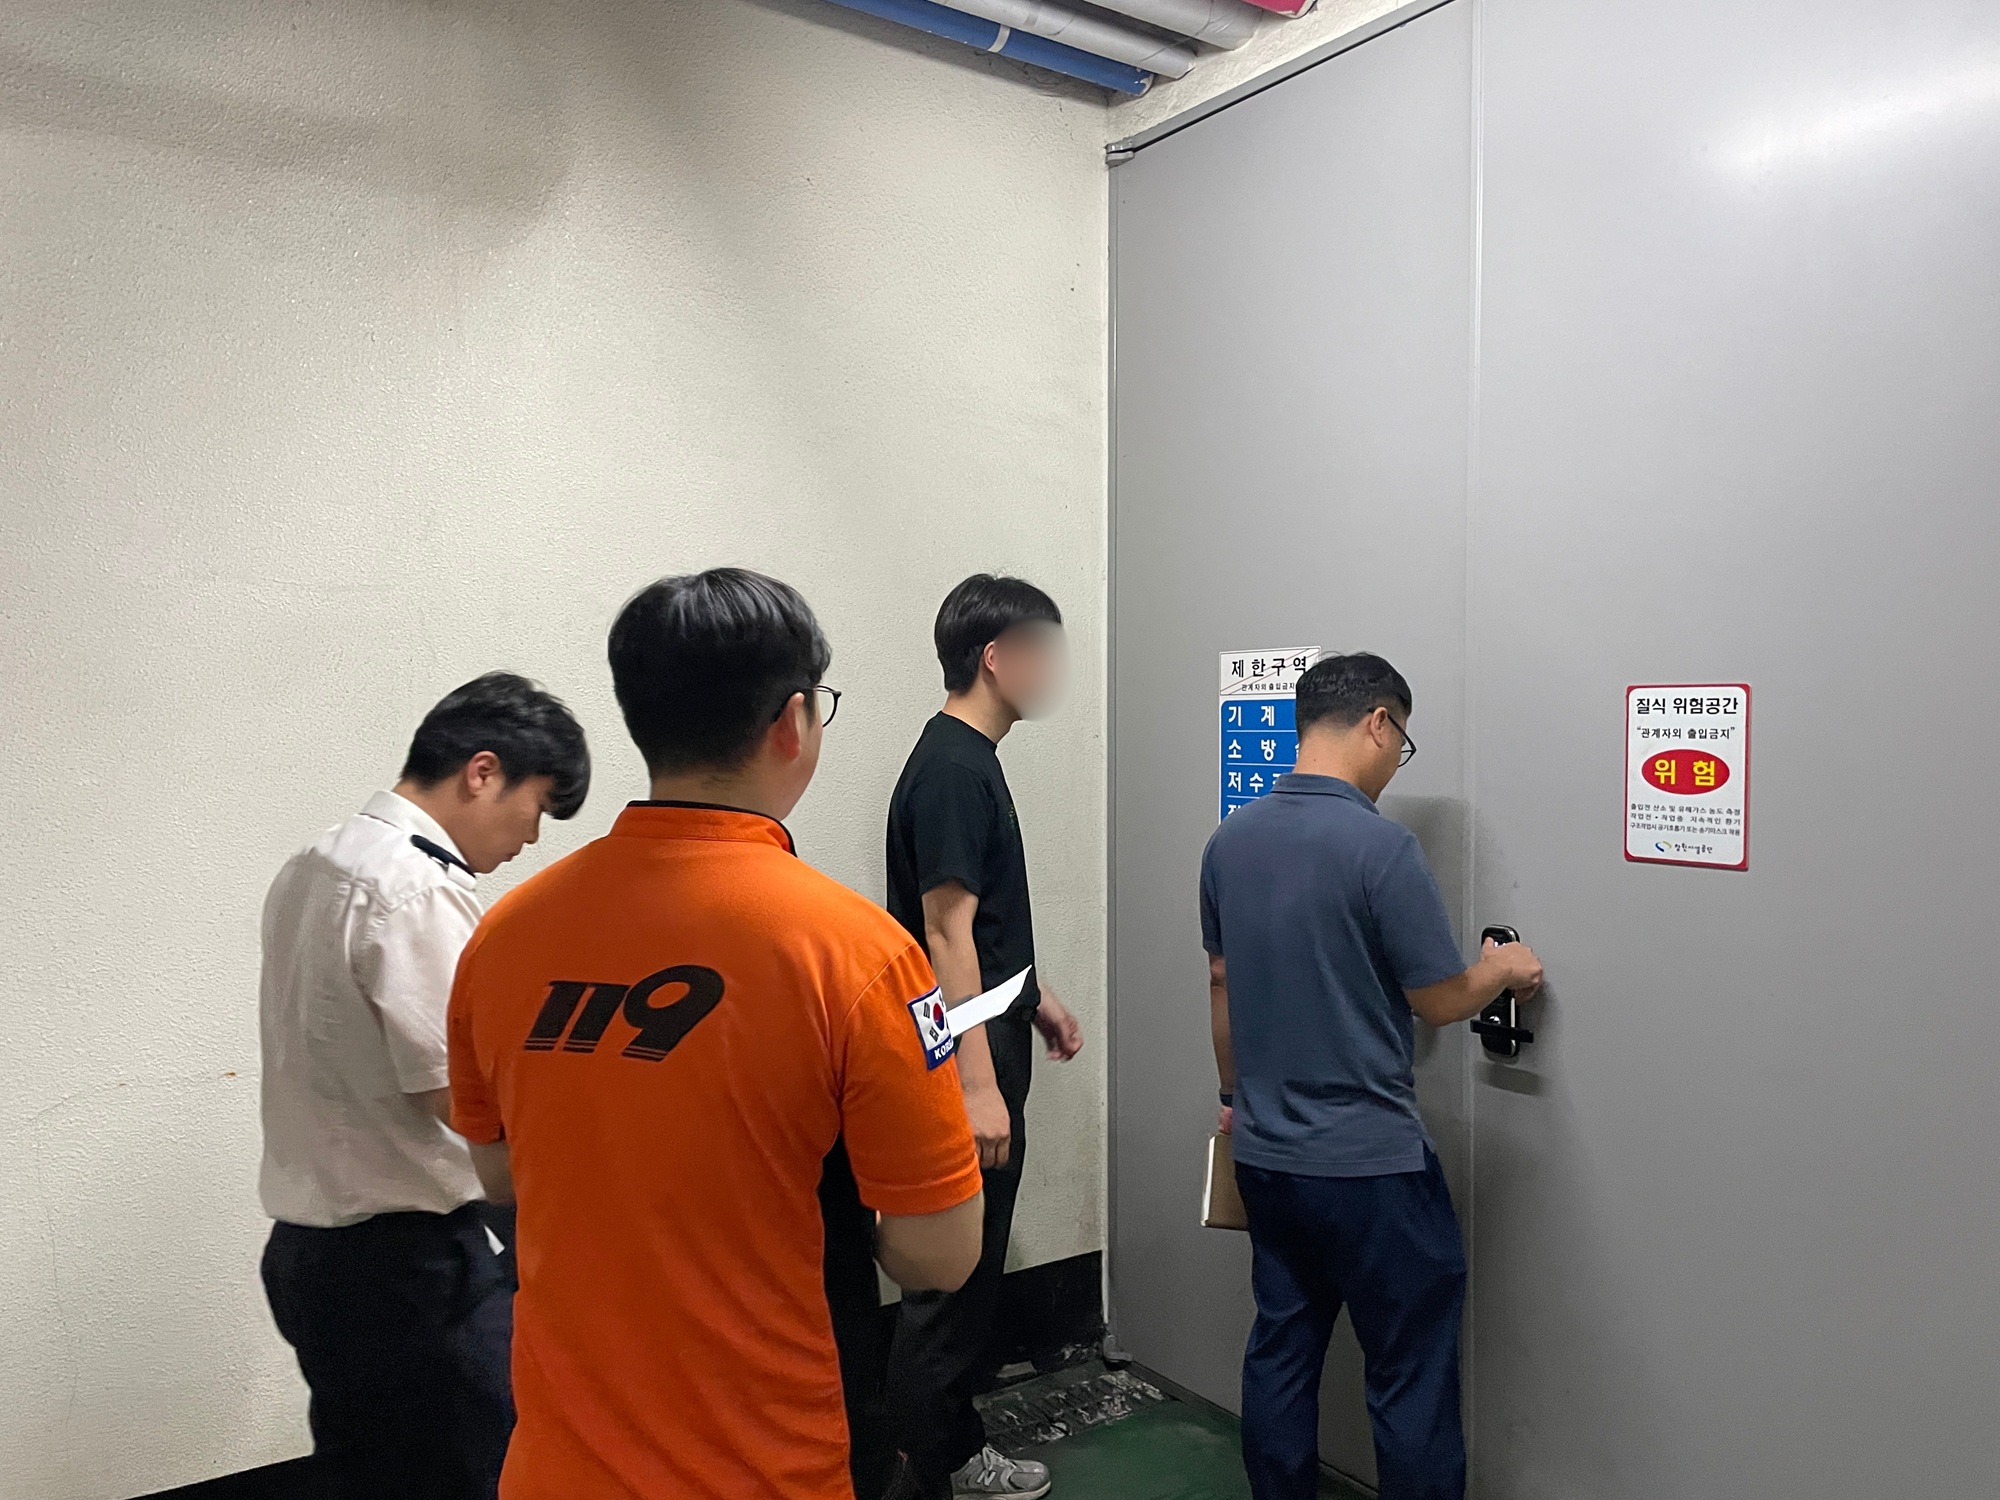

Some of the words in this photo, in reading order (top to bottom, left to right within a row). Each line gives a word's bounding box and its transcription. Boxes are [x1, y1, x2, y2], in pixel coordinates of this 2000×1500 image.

[1636, 698, 1666, 715] 질식
[1673, 697, 1739, 715] 위험공간
[1227, 738, 1299, 762] 소방
[523, 964, 726, 1063] 119
